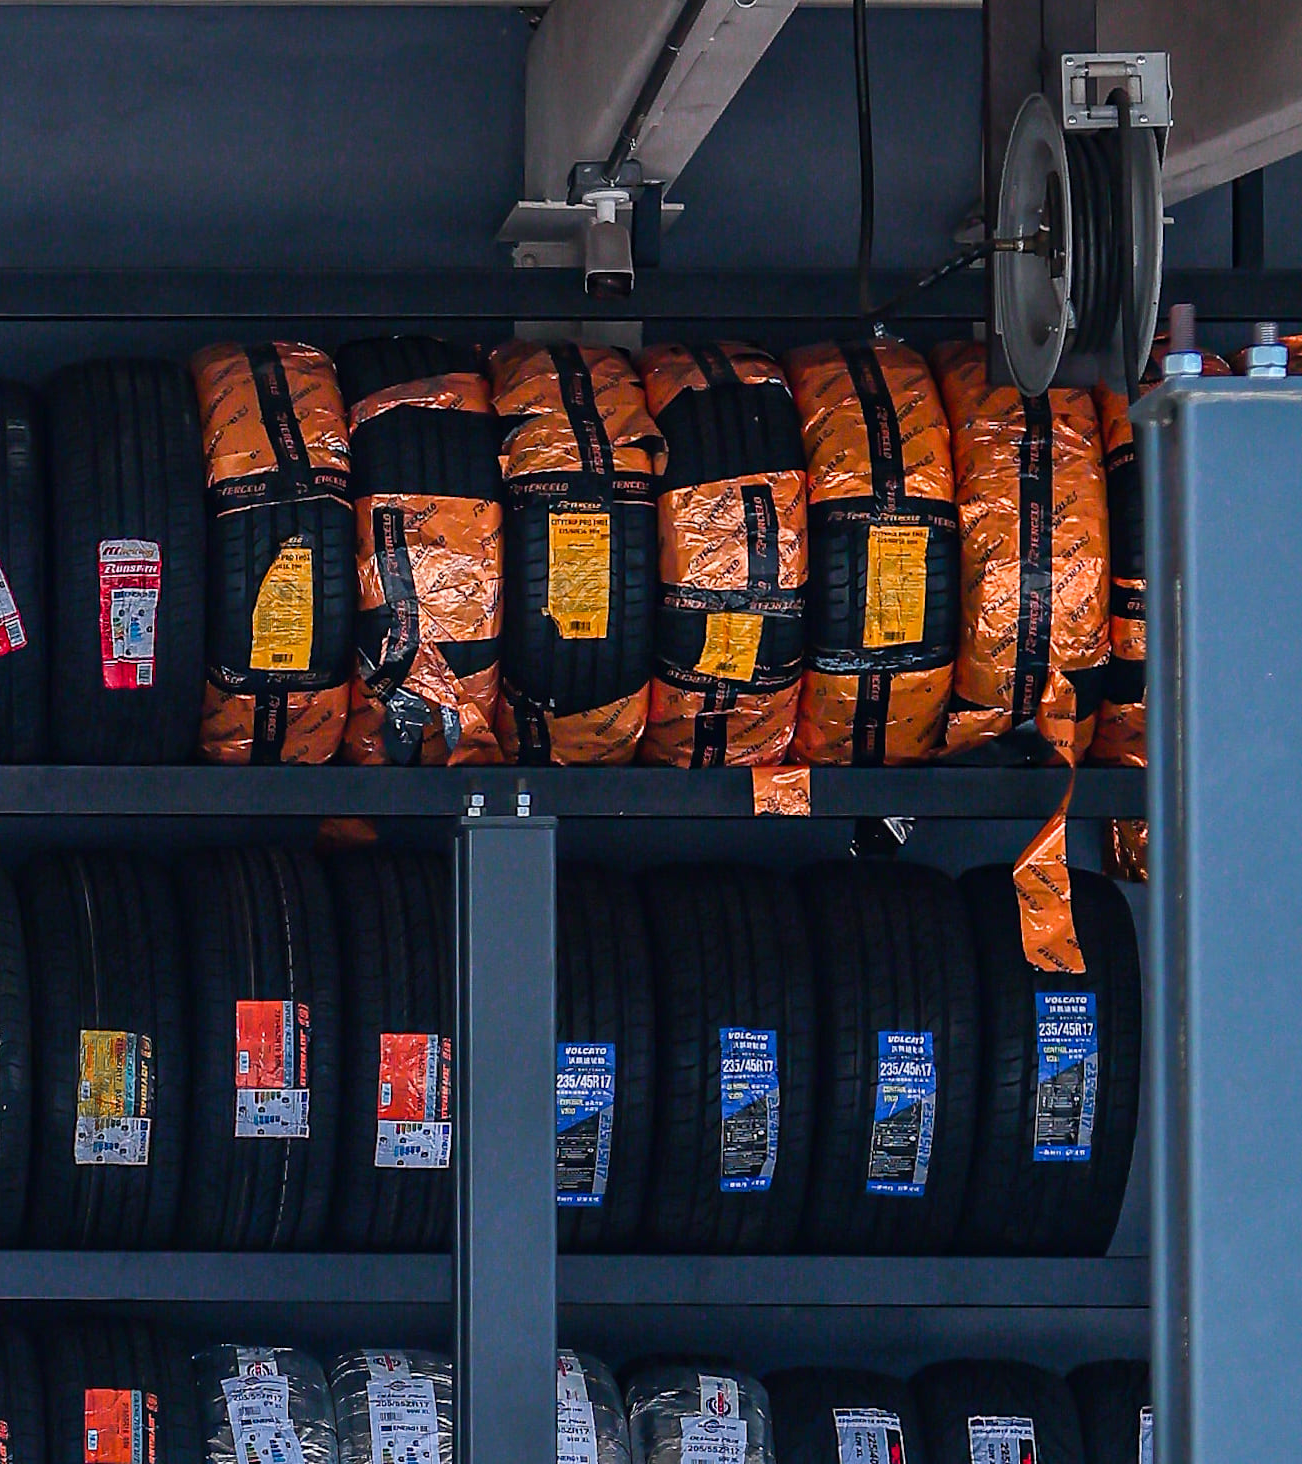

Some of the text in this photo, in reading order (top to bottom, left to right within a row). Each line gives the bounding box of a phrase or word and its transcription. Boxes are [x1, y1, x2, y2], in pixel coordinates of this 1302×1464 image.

[1029, 501, 1040, 548] TERCELO
[104, 563, 158, 575] Runspirit
[1044, 996, 1088, 1005] VOLCATO
[727, 1031, 769, 1041] VOLCATO
[1038, 1022, 1094, 1037] 235/45R17
[887, 1035, 925, 1045] VOLCATO
[564, 1046, 608, 1056] VOLCATO
[722, 1058, 774, 1073] 235/45R17
[880, 1062, 931, 1077] 235/45R17
[556, 1074, 612, 1089] 235/45R17
